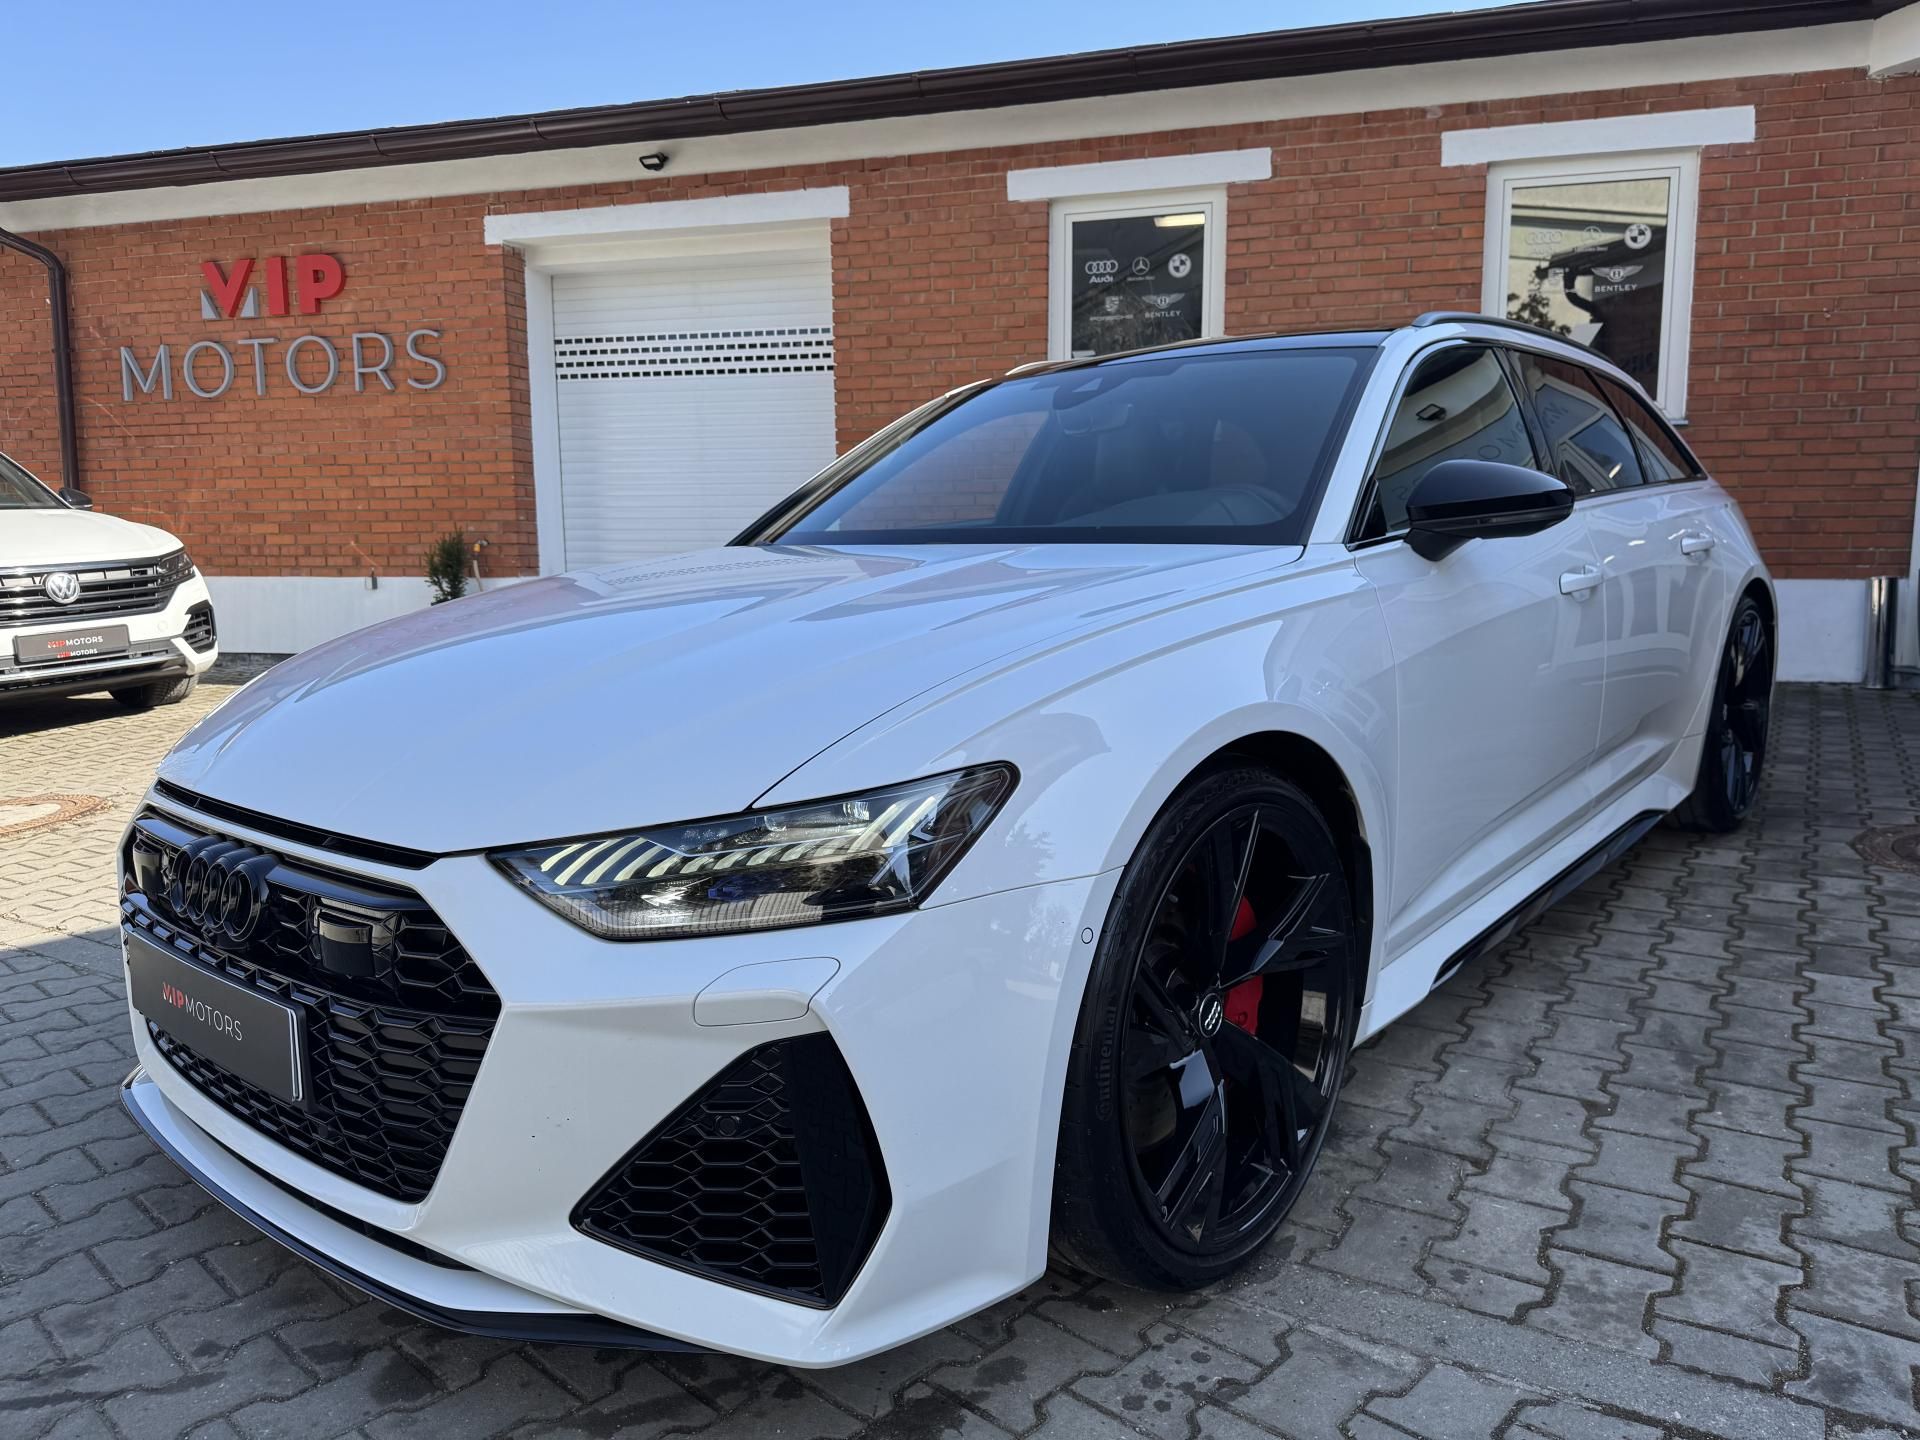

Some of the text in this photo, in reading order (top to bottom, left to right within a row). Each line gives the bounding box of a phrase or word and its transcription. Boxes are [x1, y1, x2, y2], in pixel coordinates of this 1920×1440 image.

[1088, 274, 1114, 284] Audi
[201, 254, 347, 320] VIP
[1594, 284, 1638, 293] BENTLEY
[1144, 310, 1182, 319] BENTLEY
[120, 329, 446, 401] MOTORS
